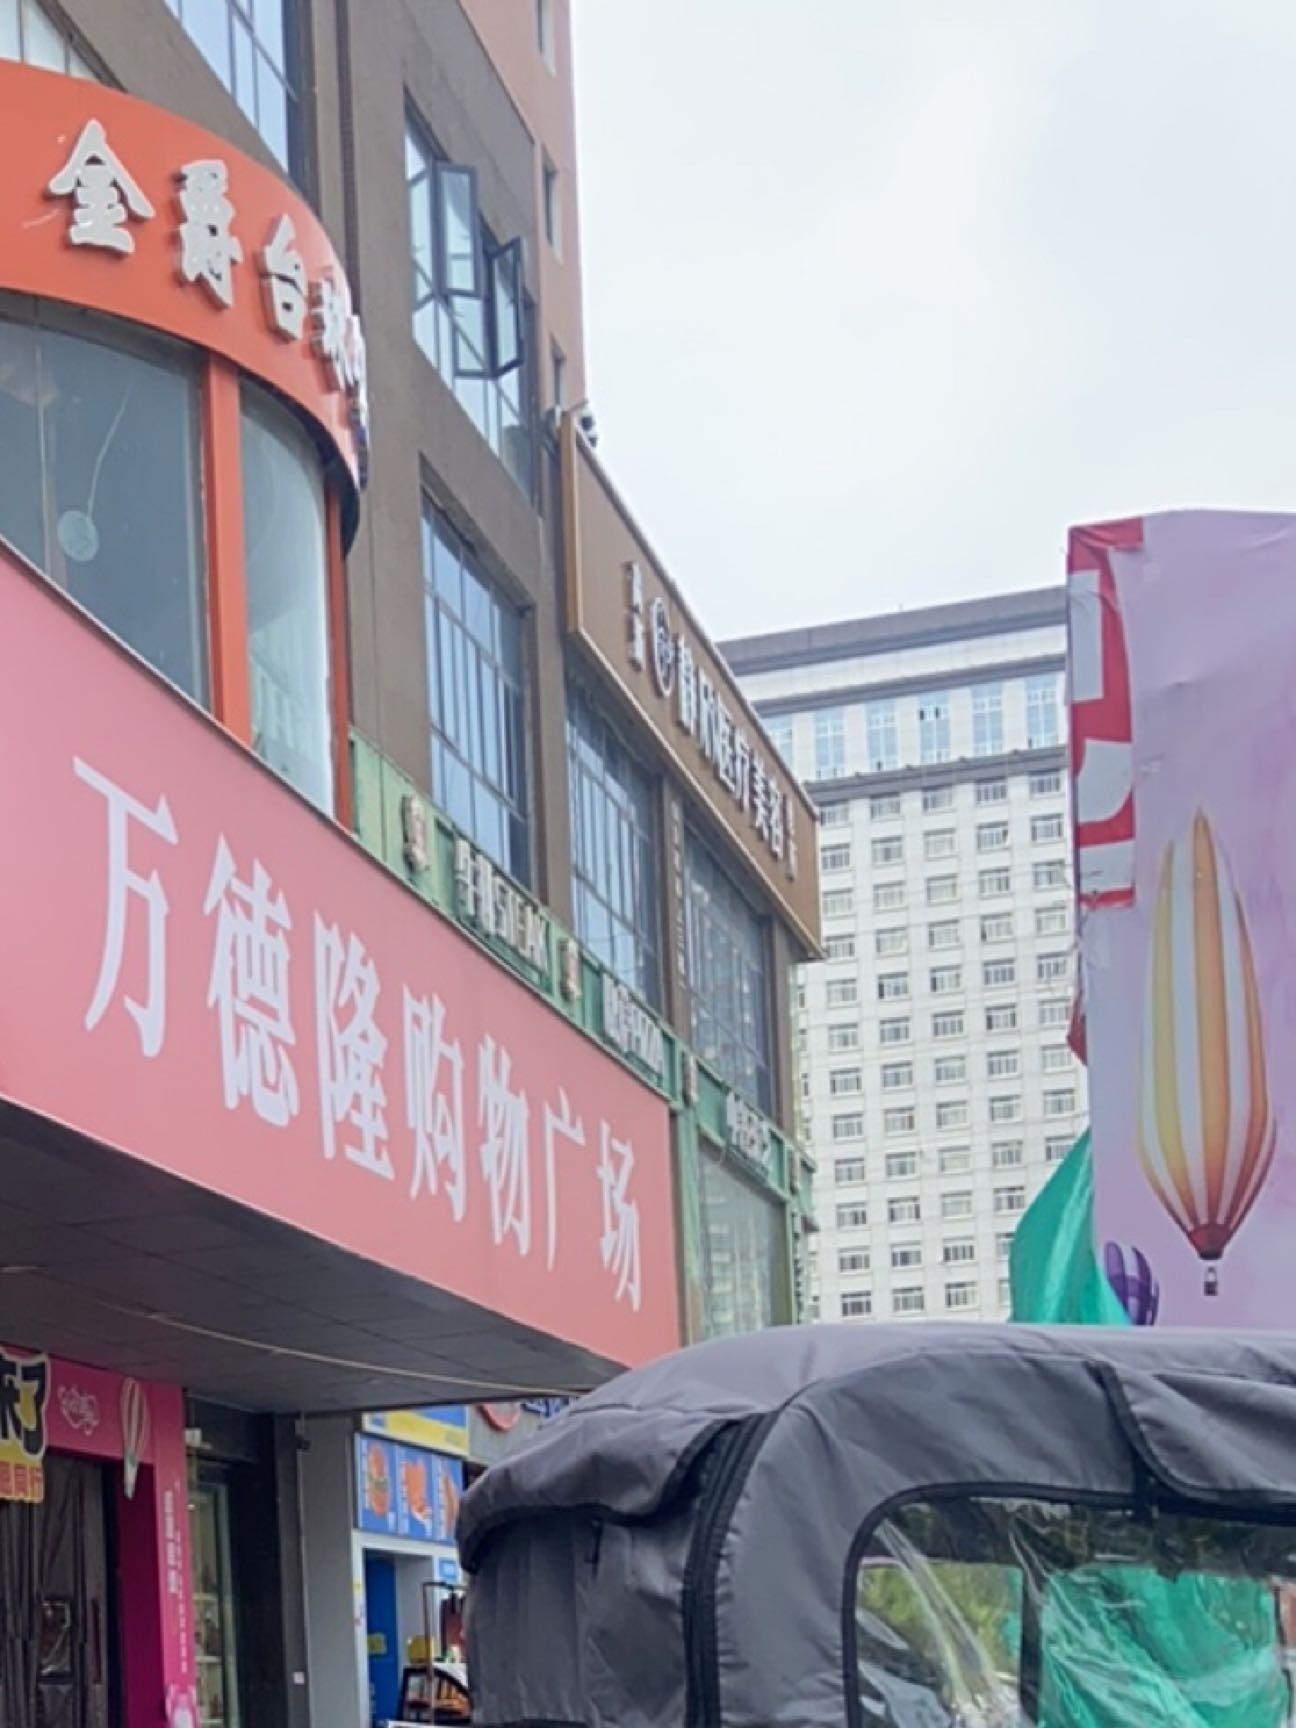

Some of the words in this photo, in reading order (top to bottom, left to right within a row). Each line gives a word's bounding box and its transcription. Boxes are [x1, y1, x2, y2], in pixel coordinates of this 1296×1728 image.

[72, 756, 640, 1311] 万德隆购物广场
